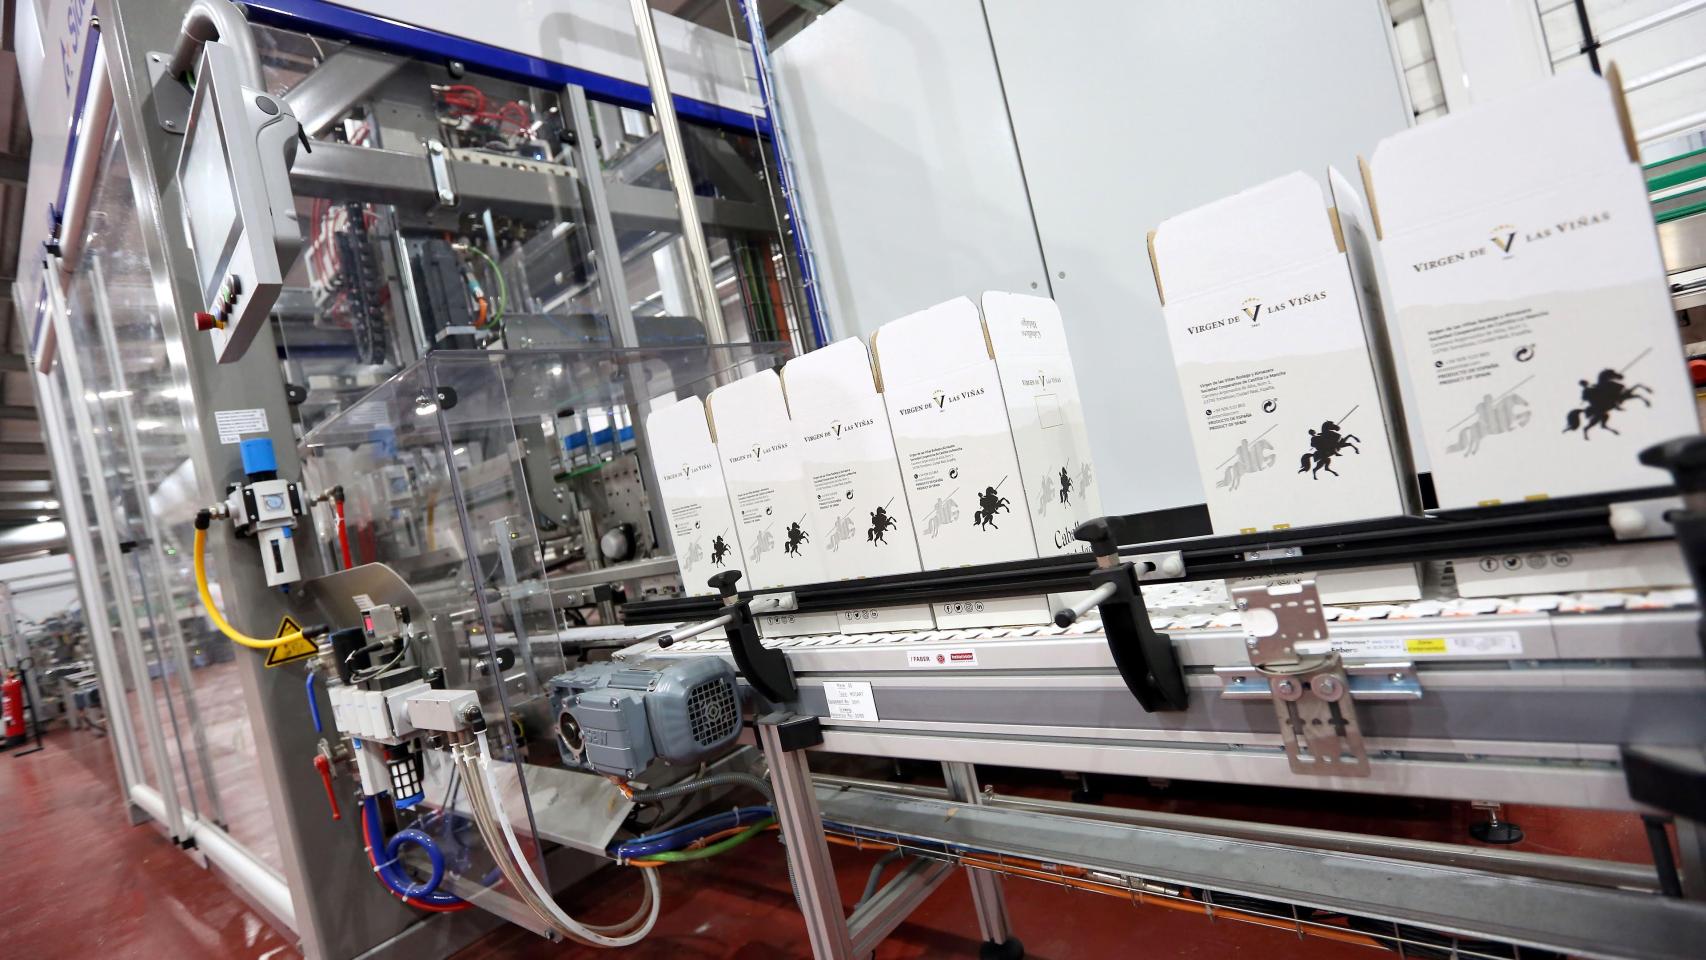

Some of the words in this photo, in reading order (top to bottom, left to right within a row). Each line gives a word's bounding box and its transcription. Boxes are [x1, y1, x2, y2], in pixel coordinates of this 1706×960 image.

[1413, 253, 1465, 273] VIRGEN
[1469, 248, 1486, 258] DE
[1526, 229, 1551, 243] LAS
[1556, 211, 1610, 233] VIÑAS
[1187, 319, 1225, 335] VIRGEN
[1228, 316, 1241, 325] DE
[1267, 303, 1286, 314] LAS
[1288, 291, 1327, 307] VIÑAS
[900, 403, 923, 416] VIRGEN
[948, 395, 960, 403] LAS
[961, 387, 985, 399] VIÑAS
[804, 432, 824, 442] VIRGEN
[854, 418, 874, 429] VIÑAS
